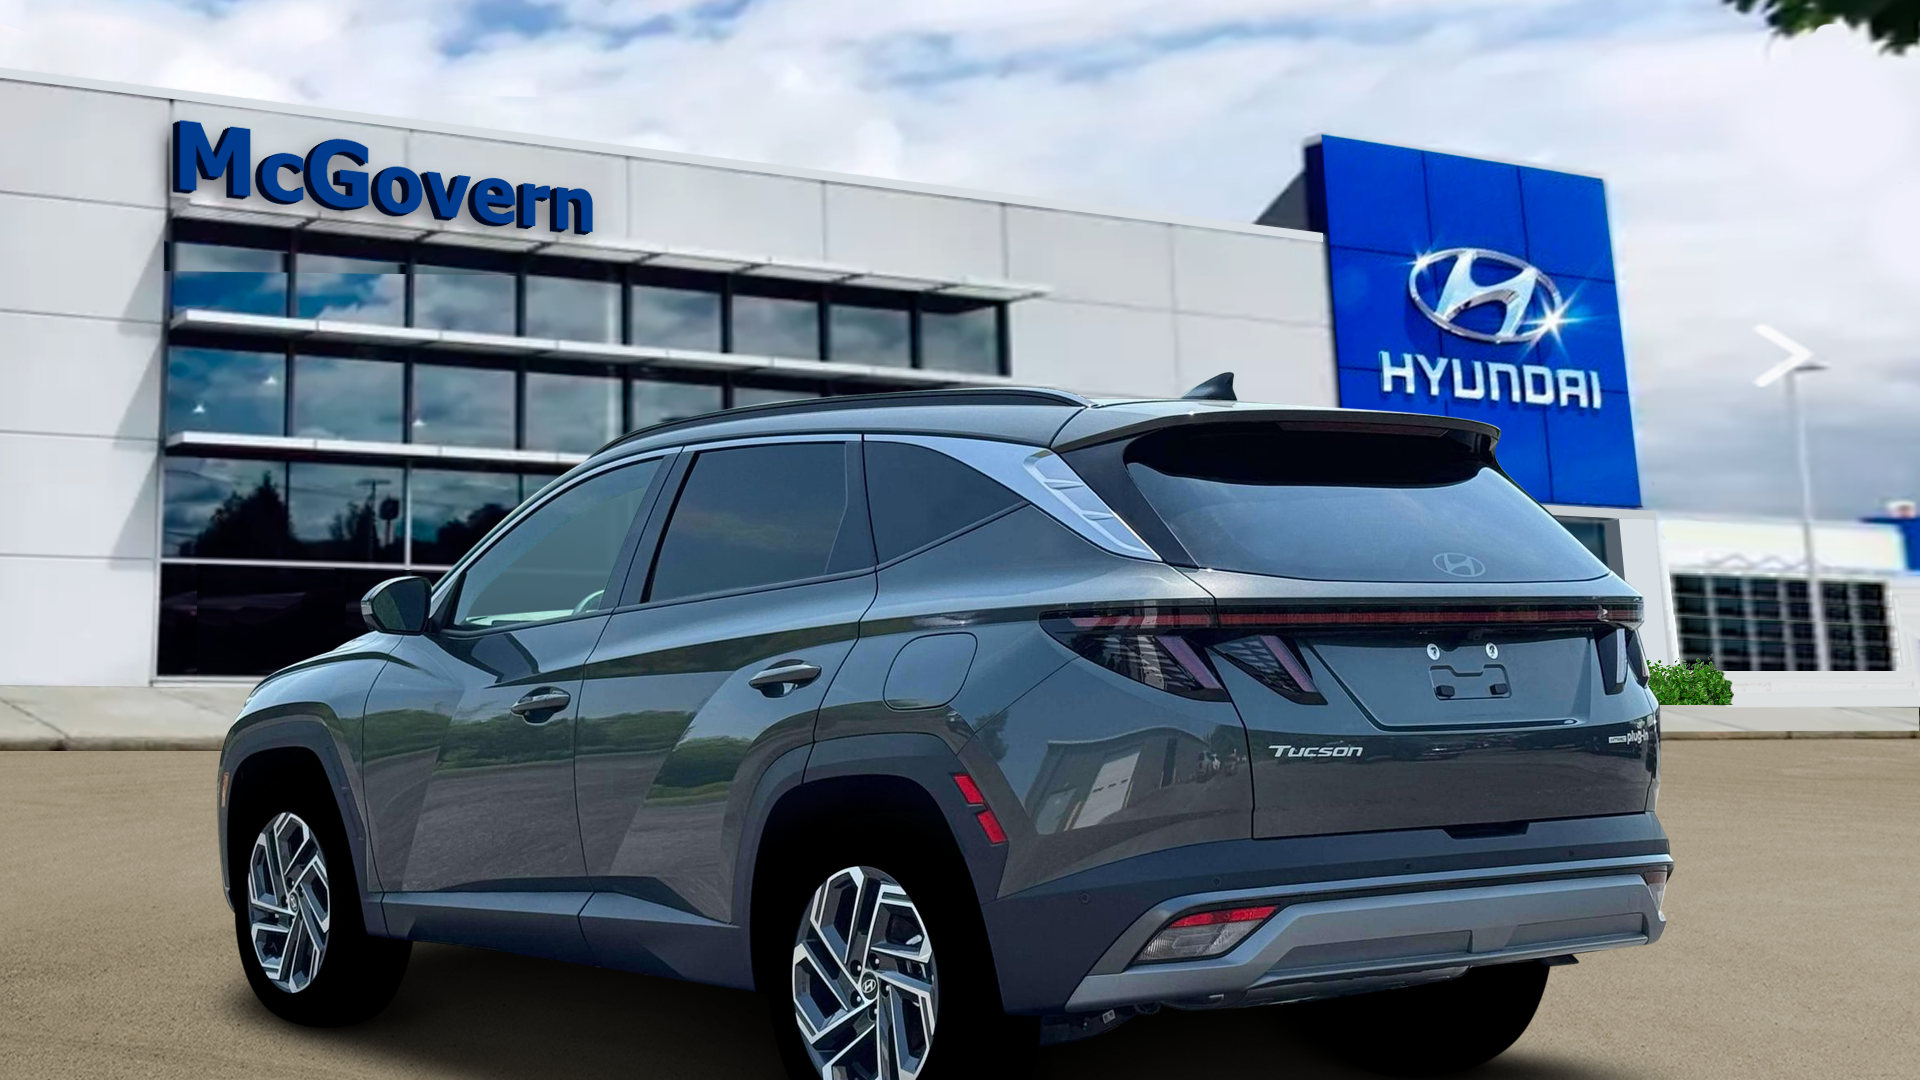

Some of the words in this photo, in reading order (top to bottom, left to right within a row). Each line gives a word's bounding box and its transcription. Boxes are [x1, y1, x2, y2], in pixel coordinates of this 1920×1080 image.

[172, 119, 594, 236] McGovern
[1378, 350, 1602, 409] HYUNDAI
[1268, 745, 1363, 757] Tucson
